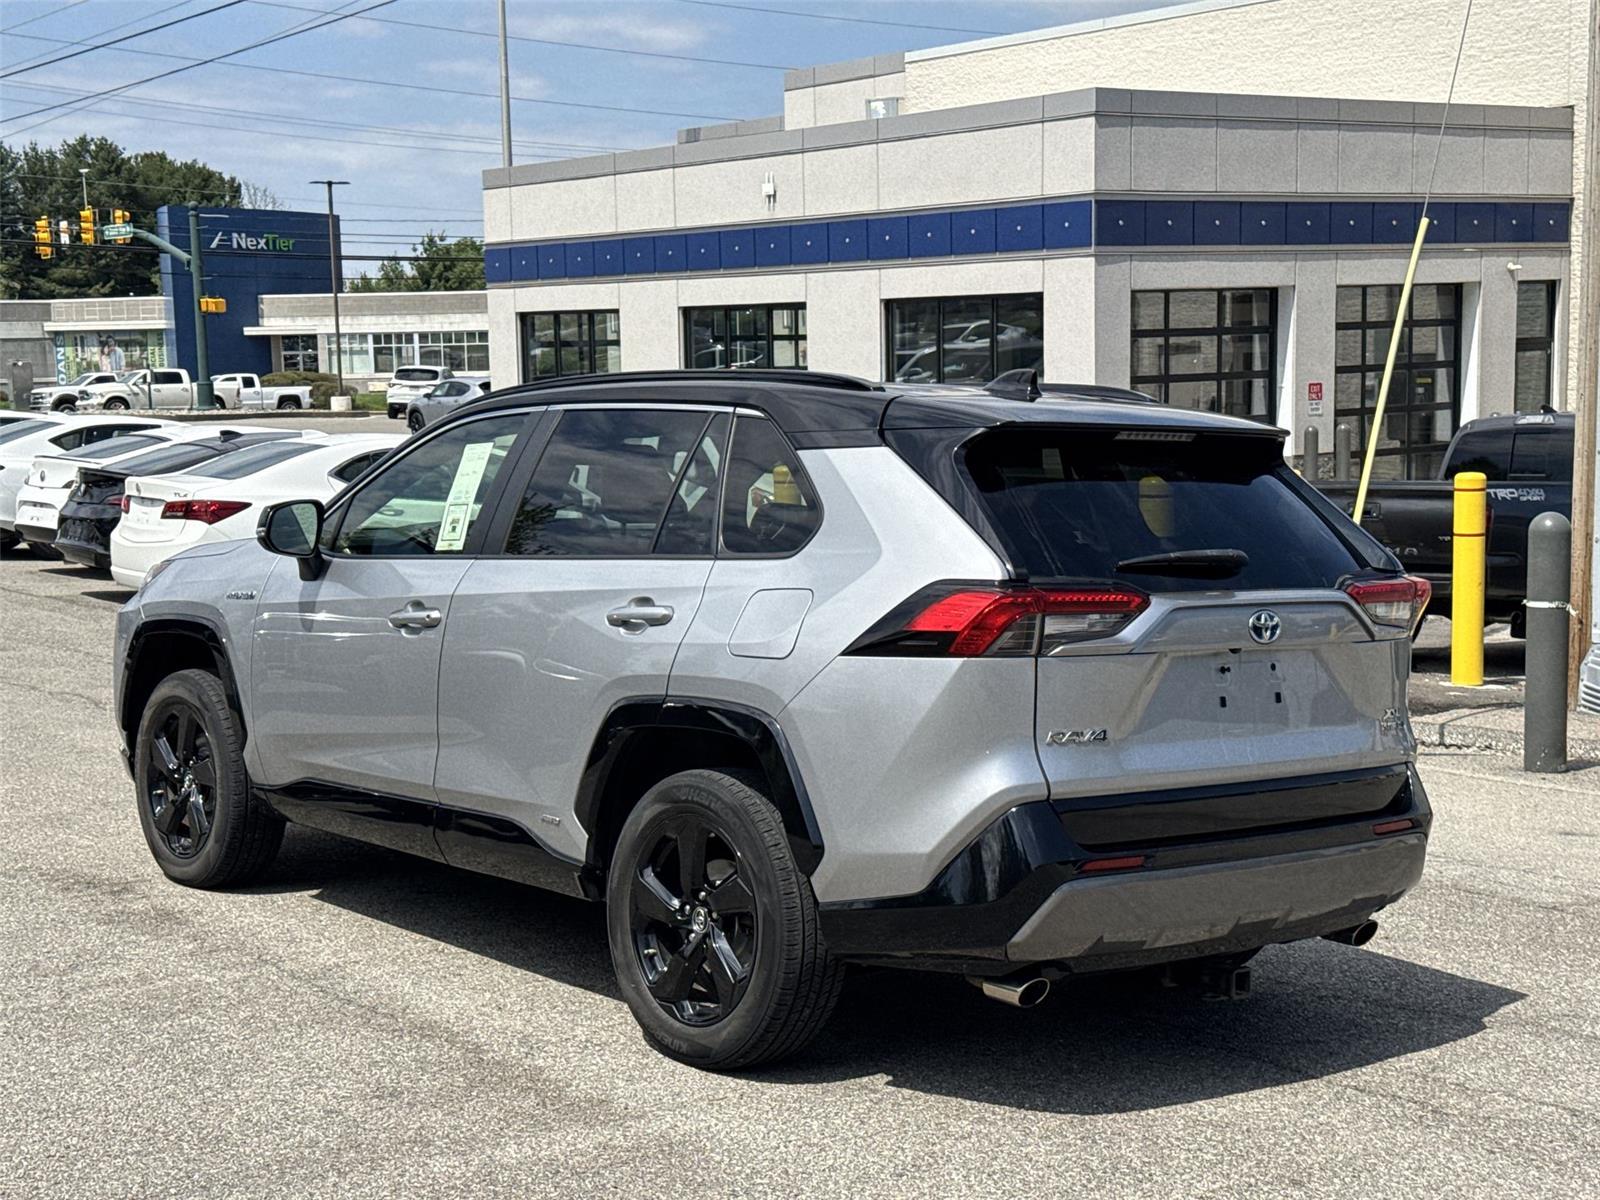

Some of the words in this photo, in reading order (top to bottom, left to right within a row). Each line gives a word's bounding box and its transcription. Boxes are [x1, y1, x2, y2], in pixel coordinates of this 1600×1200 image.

[232, 233, 294, 250] NexTier
[56, 335, 67, 385] OANS
[1045, 729, 1108, 745] RAV4
